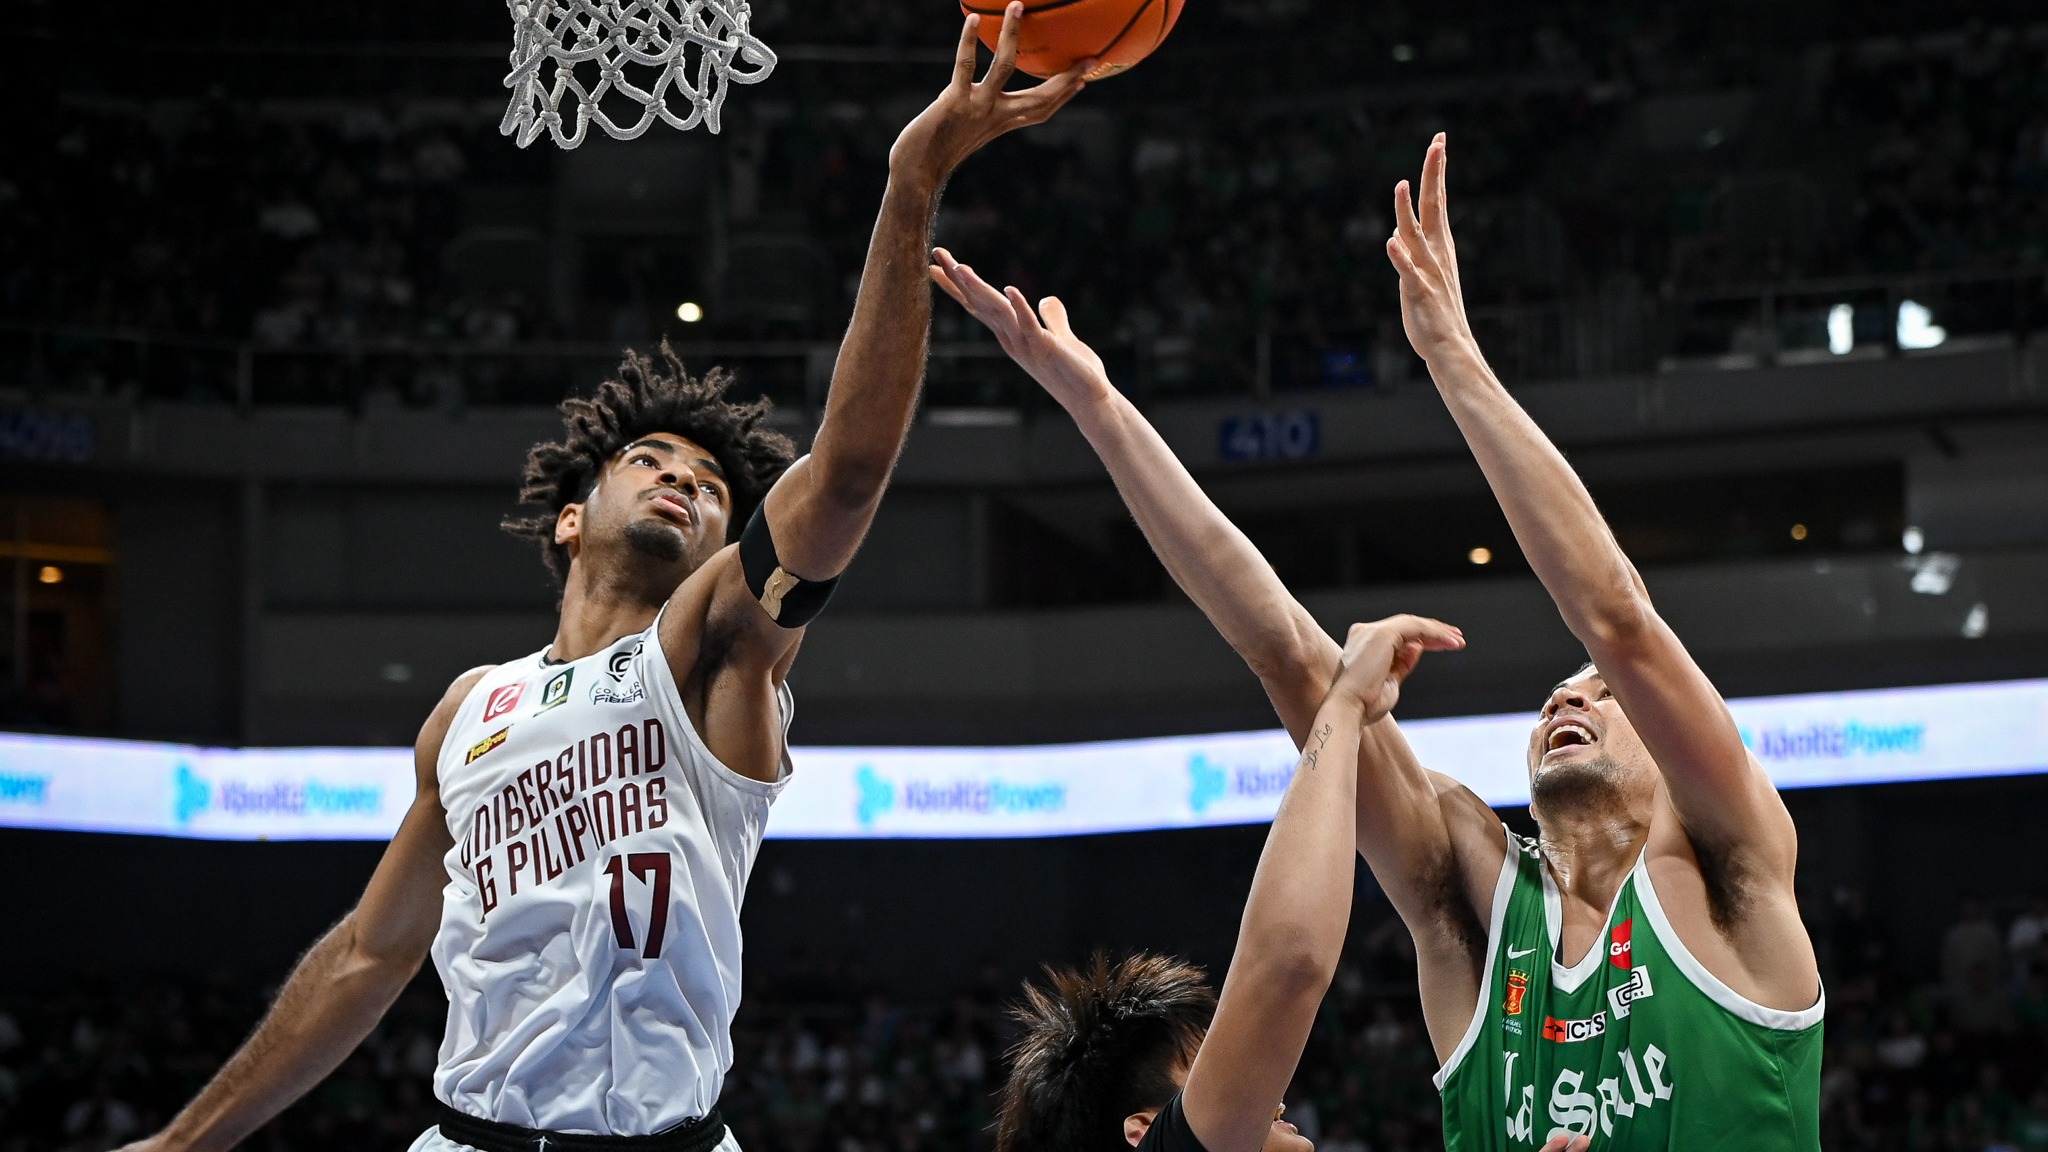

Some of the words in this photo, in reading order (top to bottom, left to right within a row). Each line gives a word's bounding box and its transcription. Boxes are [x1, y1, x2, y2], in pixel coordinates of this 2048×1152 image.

[1228, 411, 1313, 459] 410
[595, 681, 641, 698] CONVER
[476, 855, 498, 924] G
[602, 852, 672, 960] 17
[1566, 1013, 1606, 1040] ICTS
